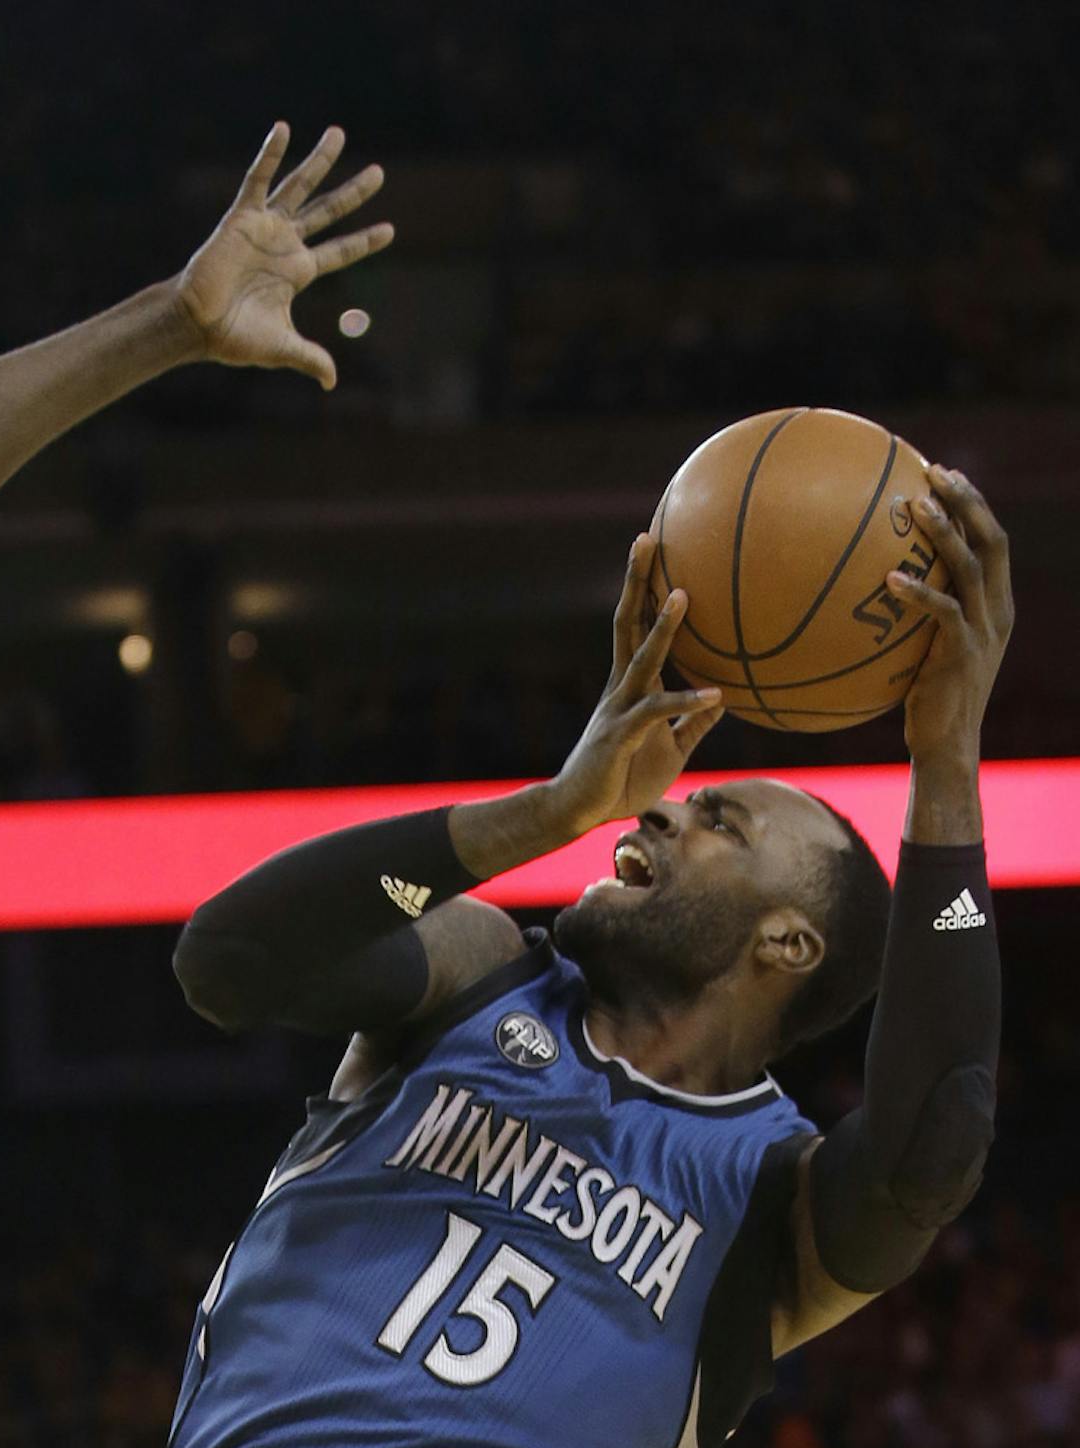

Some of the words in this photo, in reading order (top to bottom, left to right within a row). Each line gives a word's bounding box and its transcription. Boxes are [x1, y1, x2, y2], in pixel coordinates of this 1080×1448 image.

[932, 912, 987, 931] adidas
[503, 1018, 556, 1060] FLIP
[384, 1083, 704, 1323] MINNESOTA
[376, 1210, 557, 1387] 15
